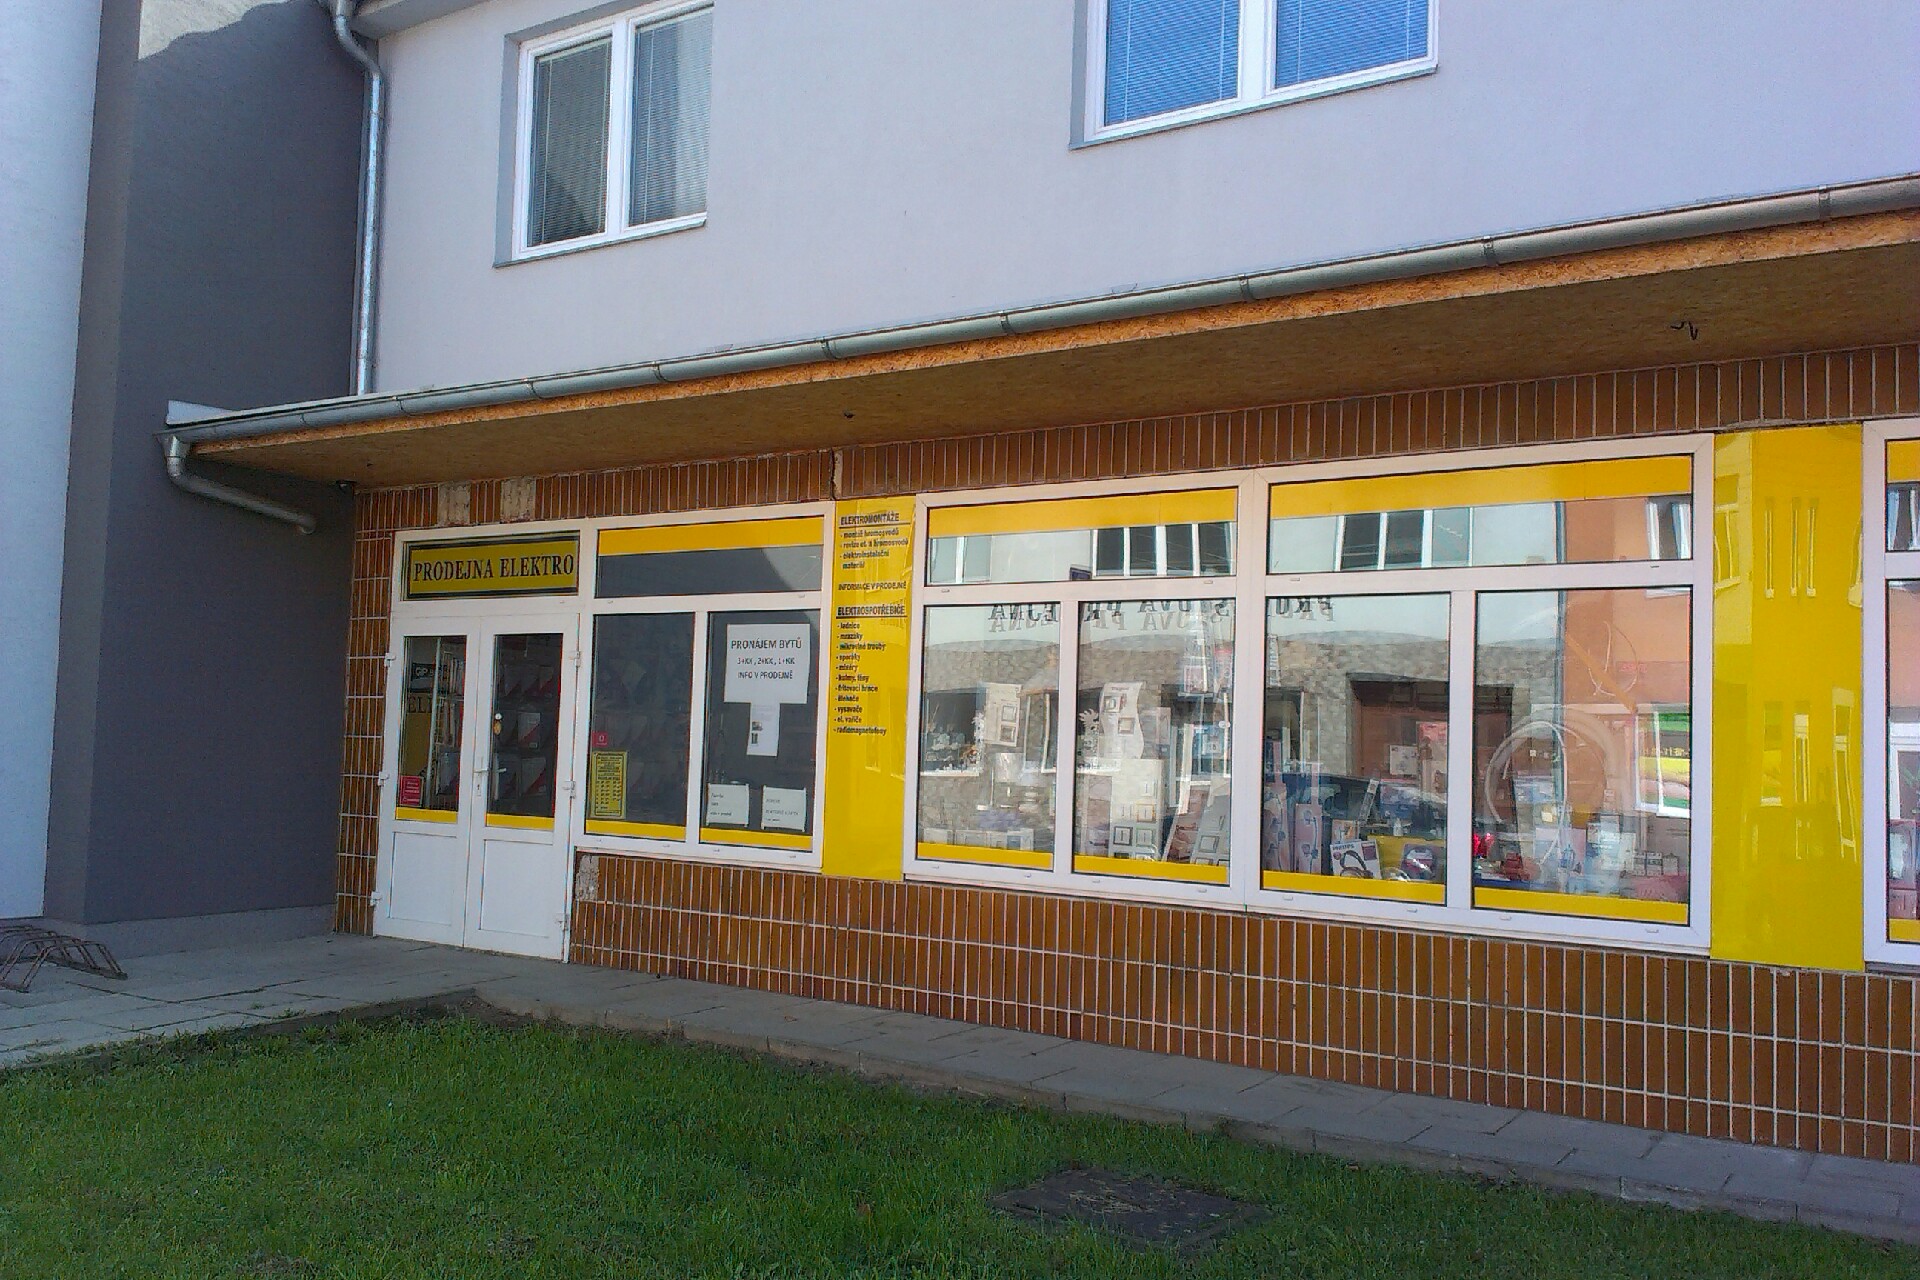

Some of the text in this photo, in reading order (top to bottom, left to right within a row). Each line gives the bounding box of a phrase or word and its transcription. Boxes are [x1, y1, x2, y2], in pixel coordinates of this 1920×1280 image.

[840, 512, 899, 525] ELEKTROMONTÁŽE
[413, 554, 574, 582] PRODEJNA ELEKTRO
[837, 603, 906, 616] ELEKTROSPOTŘEBIČE
[731, 636, 802, 650] PRONÁJEM BYTŮ
[737, 670, 793, 680] INFO V PRODEJNĚ
